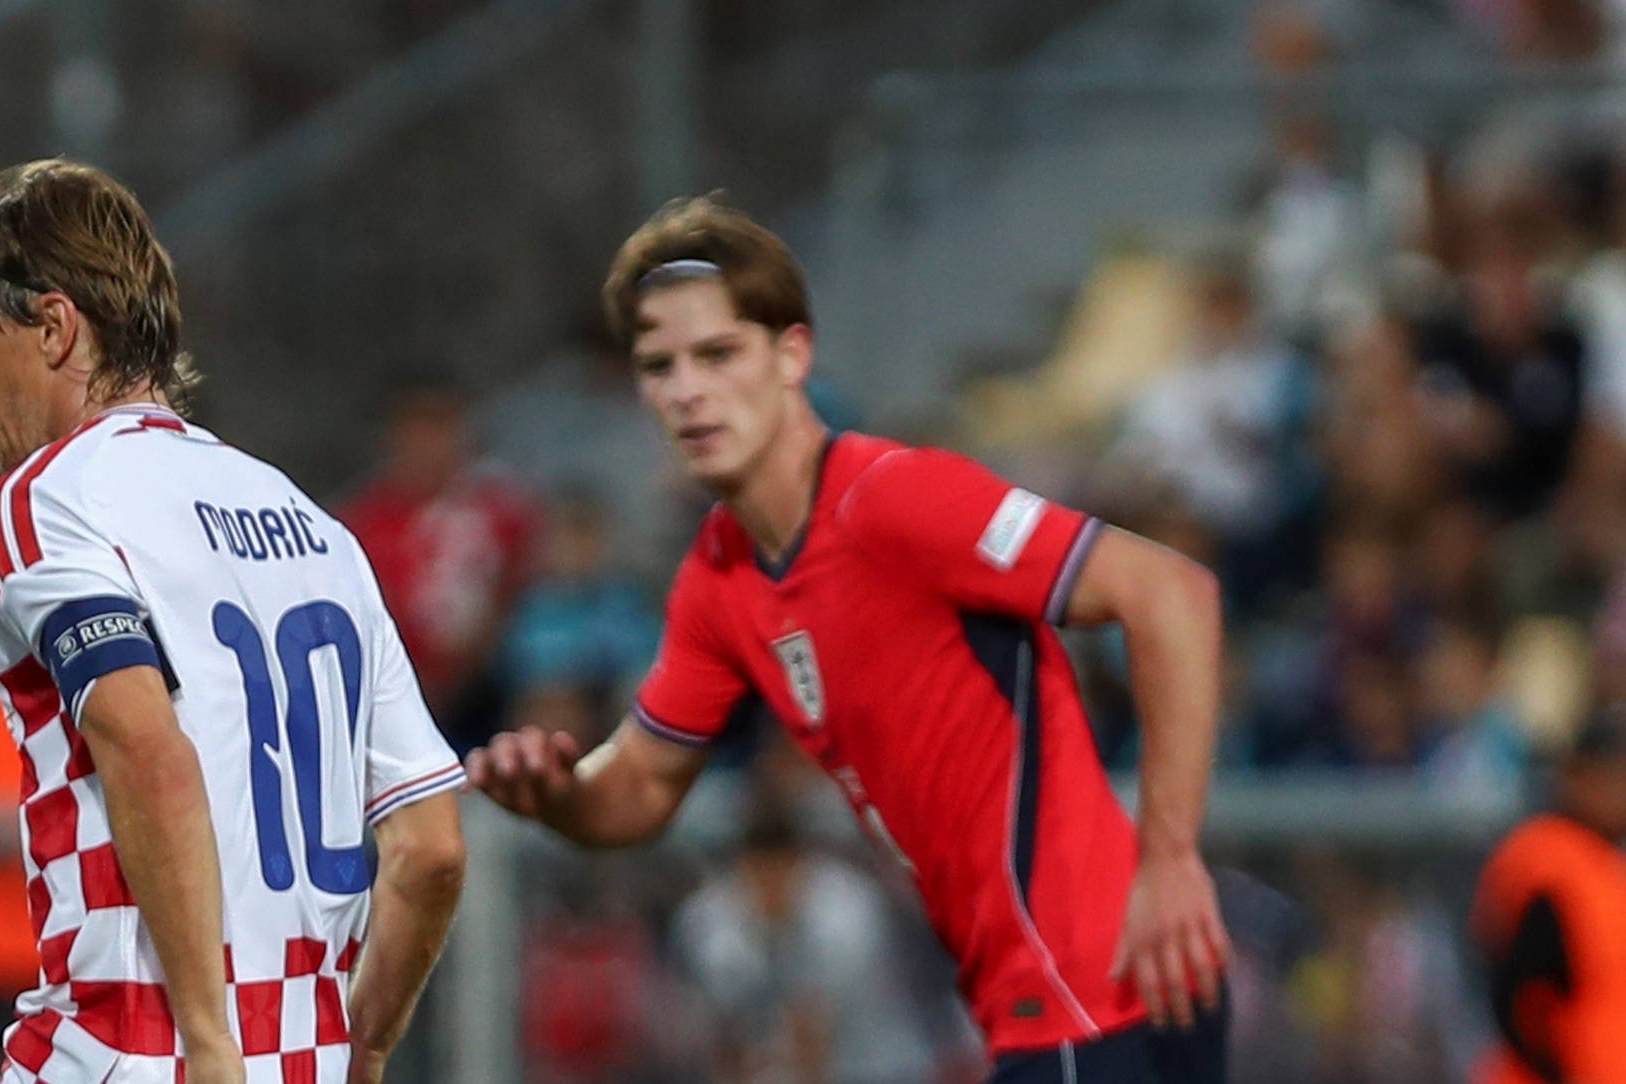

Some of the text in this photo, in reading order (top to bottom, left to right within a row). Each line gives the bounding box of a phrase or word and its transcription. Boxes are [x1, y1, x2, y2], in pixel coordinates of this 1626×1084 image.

[194, 496, 328, 561] MODRIĆ
[79, 617, 149, 644] RESPEC
[211, 600, 376, 894] 10
